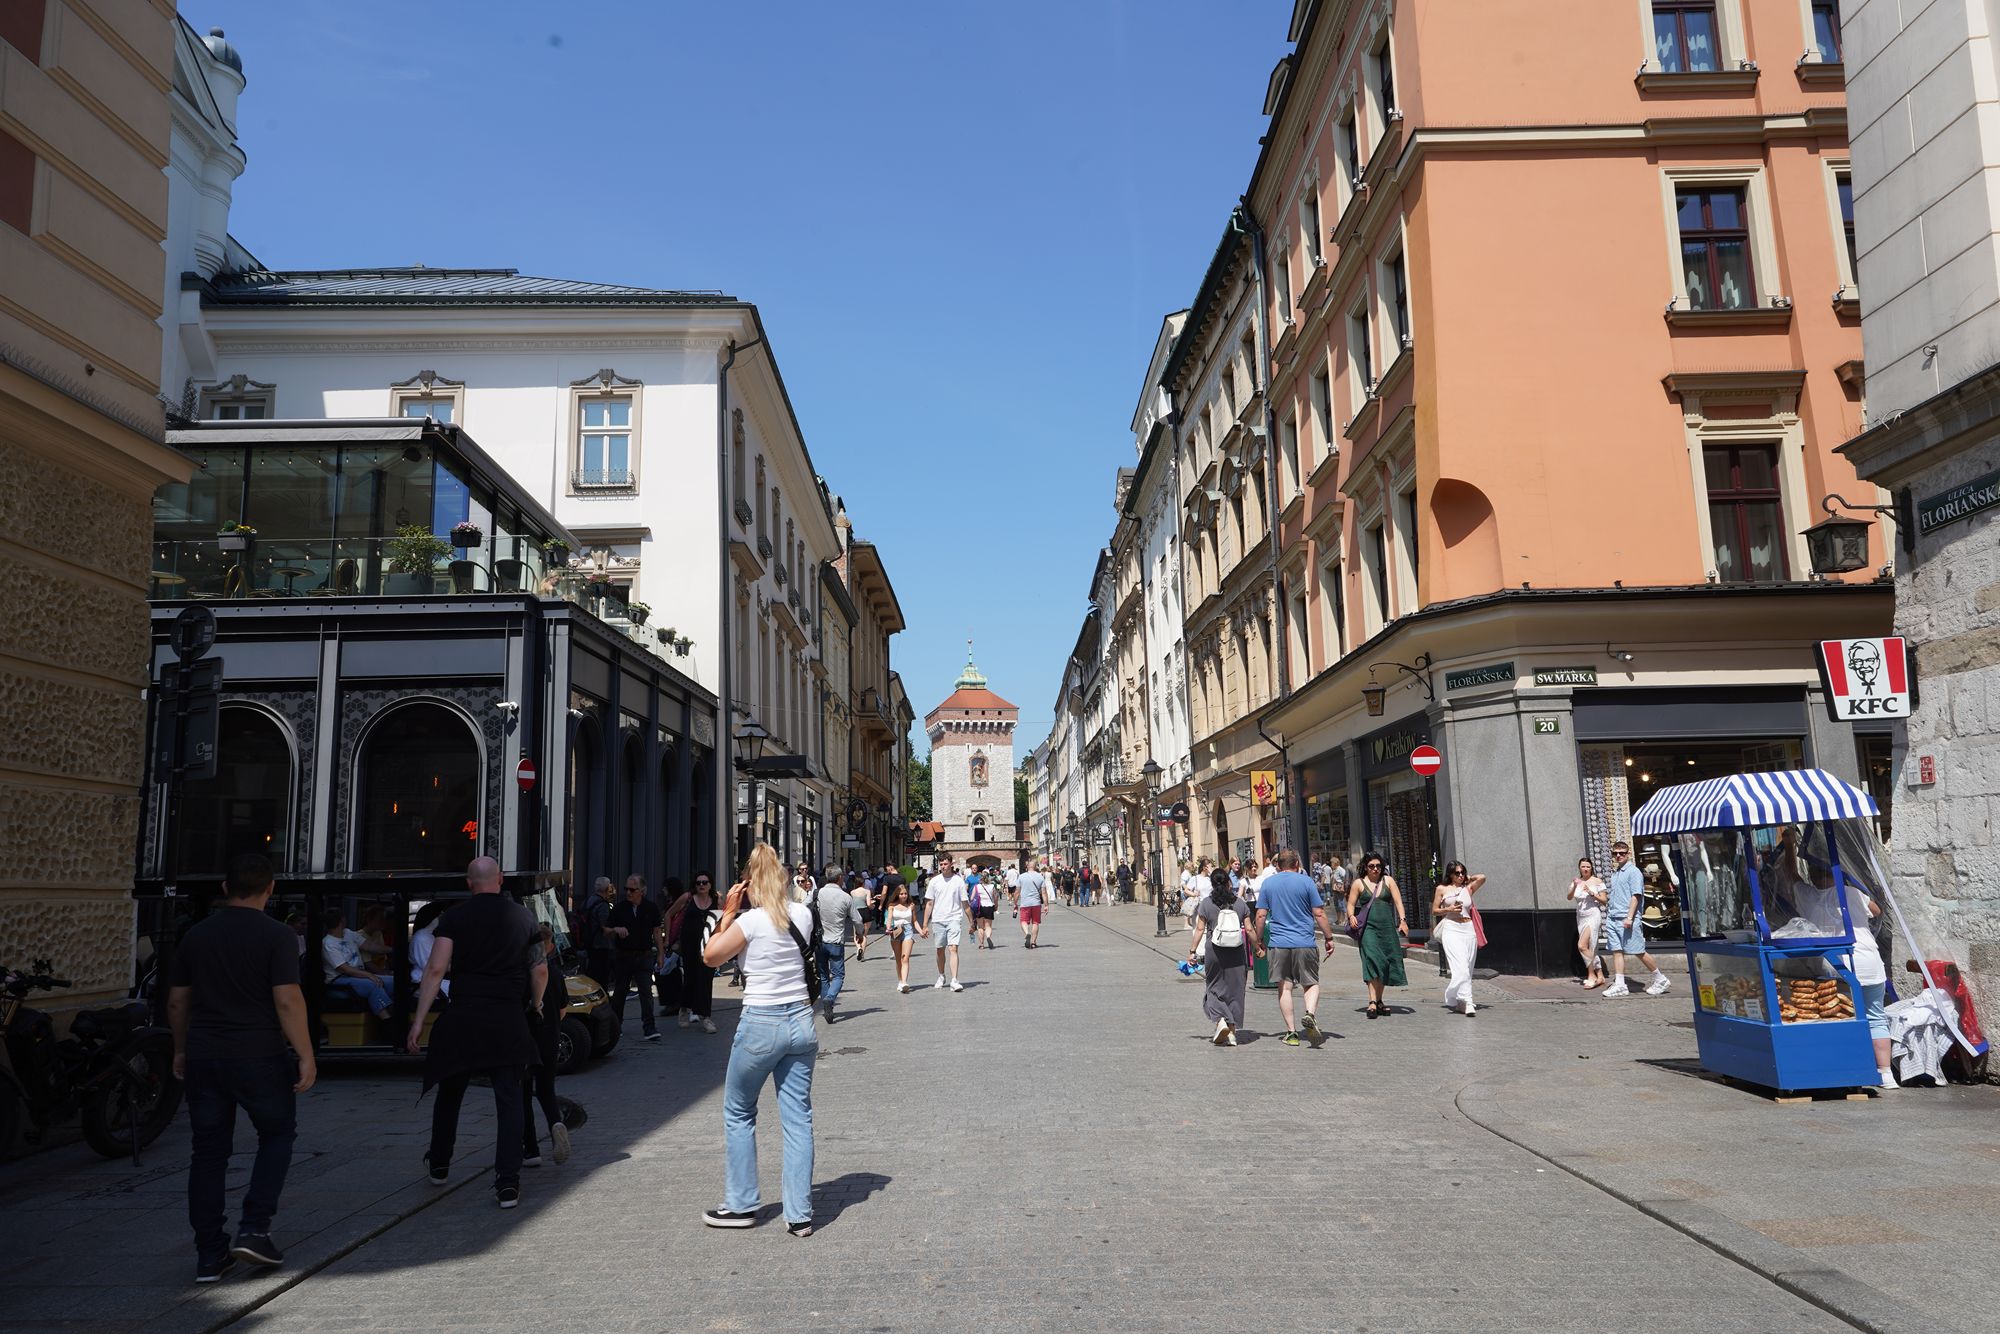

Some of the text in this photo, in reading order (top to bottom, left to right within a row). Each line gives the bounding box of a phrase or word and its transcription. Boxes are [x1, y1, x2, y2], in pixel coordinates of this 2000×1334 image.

[1448, 671, 1512, 689] FLORIAŃSKA
[1554, 673, 1594, 683] MARKA
[1848, 696, 1898, 715] KFC
[1540, 721, 1555, 732] 20
